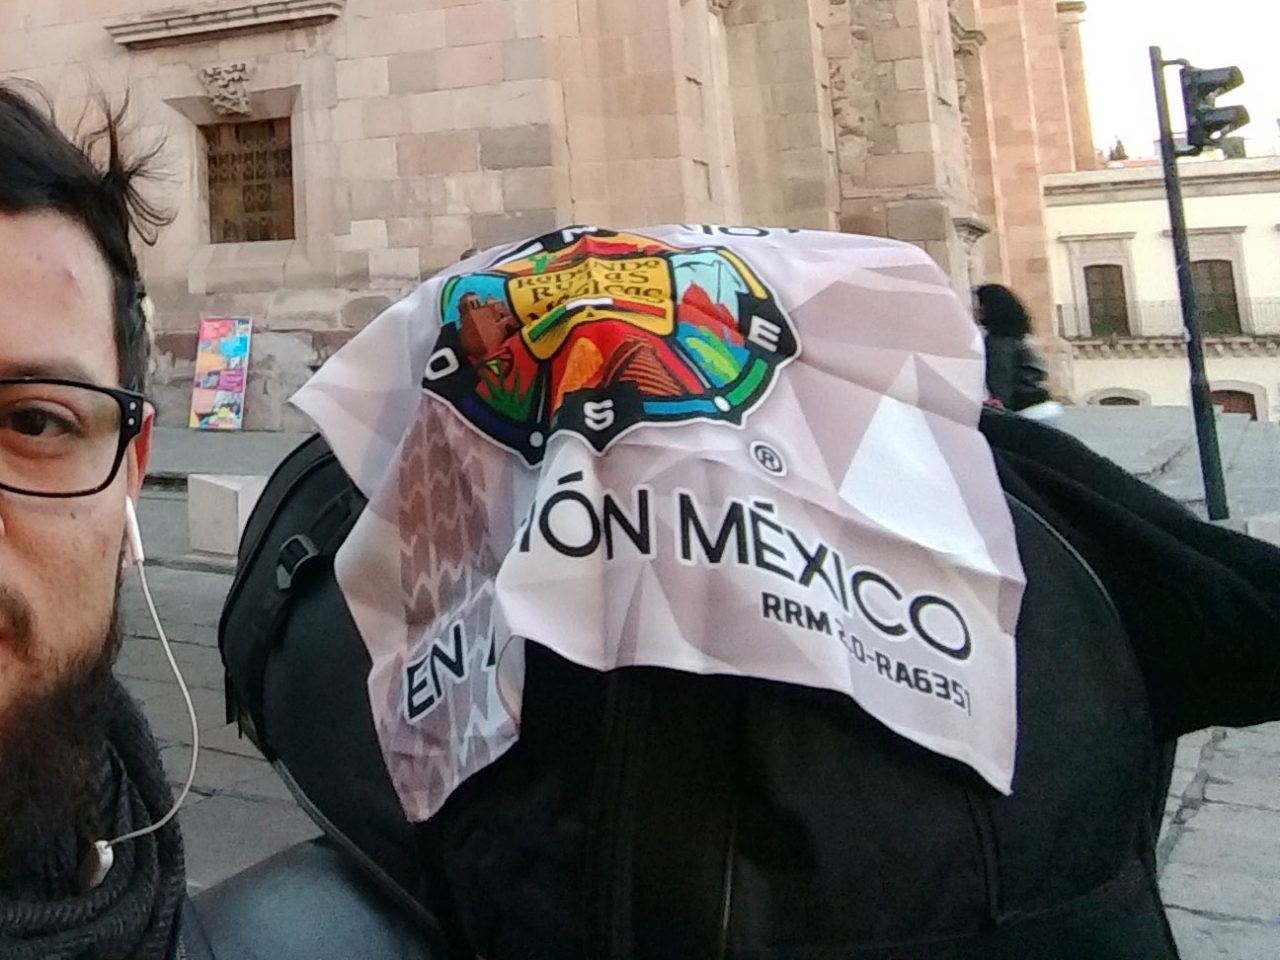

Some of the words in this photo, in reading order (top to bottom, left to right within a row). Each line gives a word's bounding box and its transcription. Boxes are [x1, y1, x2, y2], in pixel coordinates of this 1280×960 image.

[583, 399, 614, 431] S
[519, 470, 651, 561] IÓN
[677, 490, 973, 661] MÉXICO
[762, 592, 832, 636] RRM
[406, 623, 465, 720] EN
